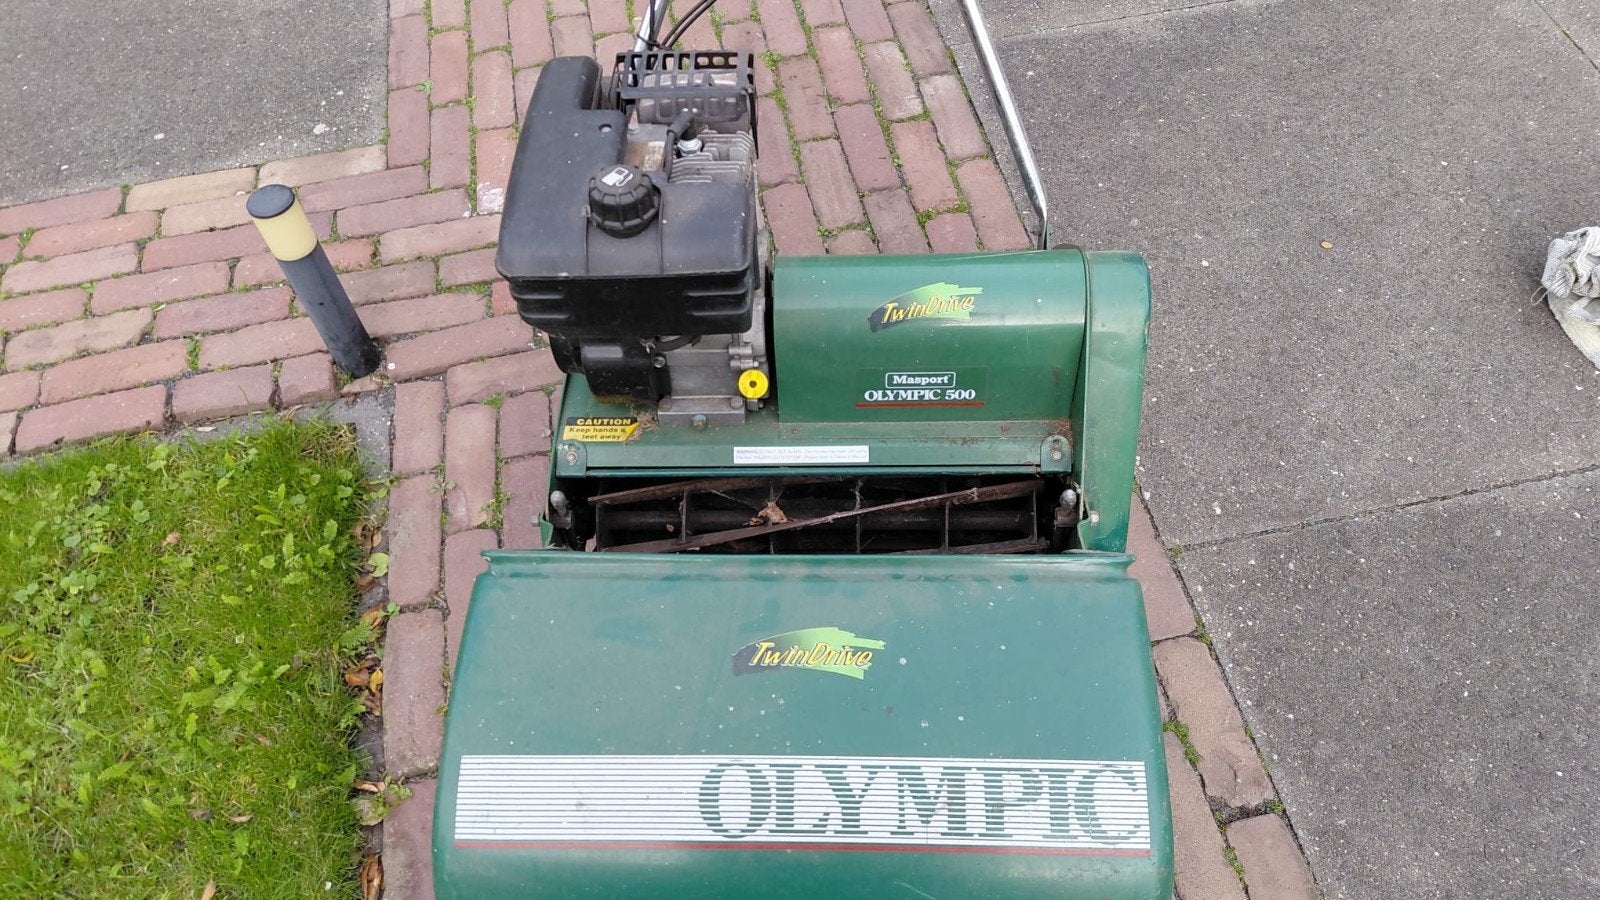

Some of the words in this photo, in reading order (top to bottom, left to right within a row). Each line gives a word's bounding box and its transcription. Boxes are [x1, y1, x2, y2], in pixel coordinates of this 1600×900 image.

[881, 295, 975, 323] TwinDrive
[892, 374, 950, 386] Masport
[864, 389, 941, 401] OLYMPIC
[945, 389, 976, 400] 500
[749, 641, 872, 669] TwinDrive
[699, 761, 1147, 845] OLYMPIC
